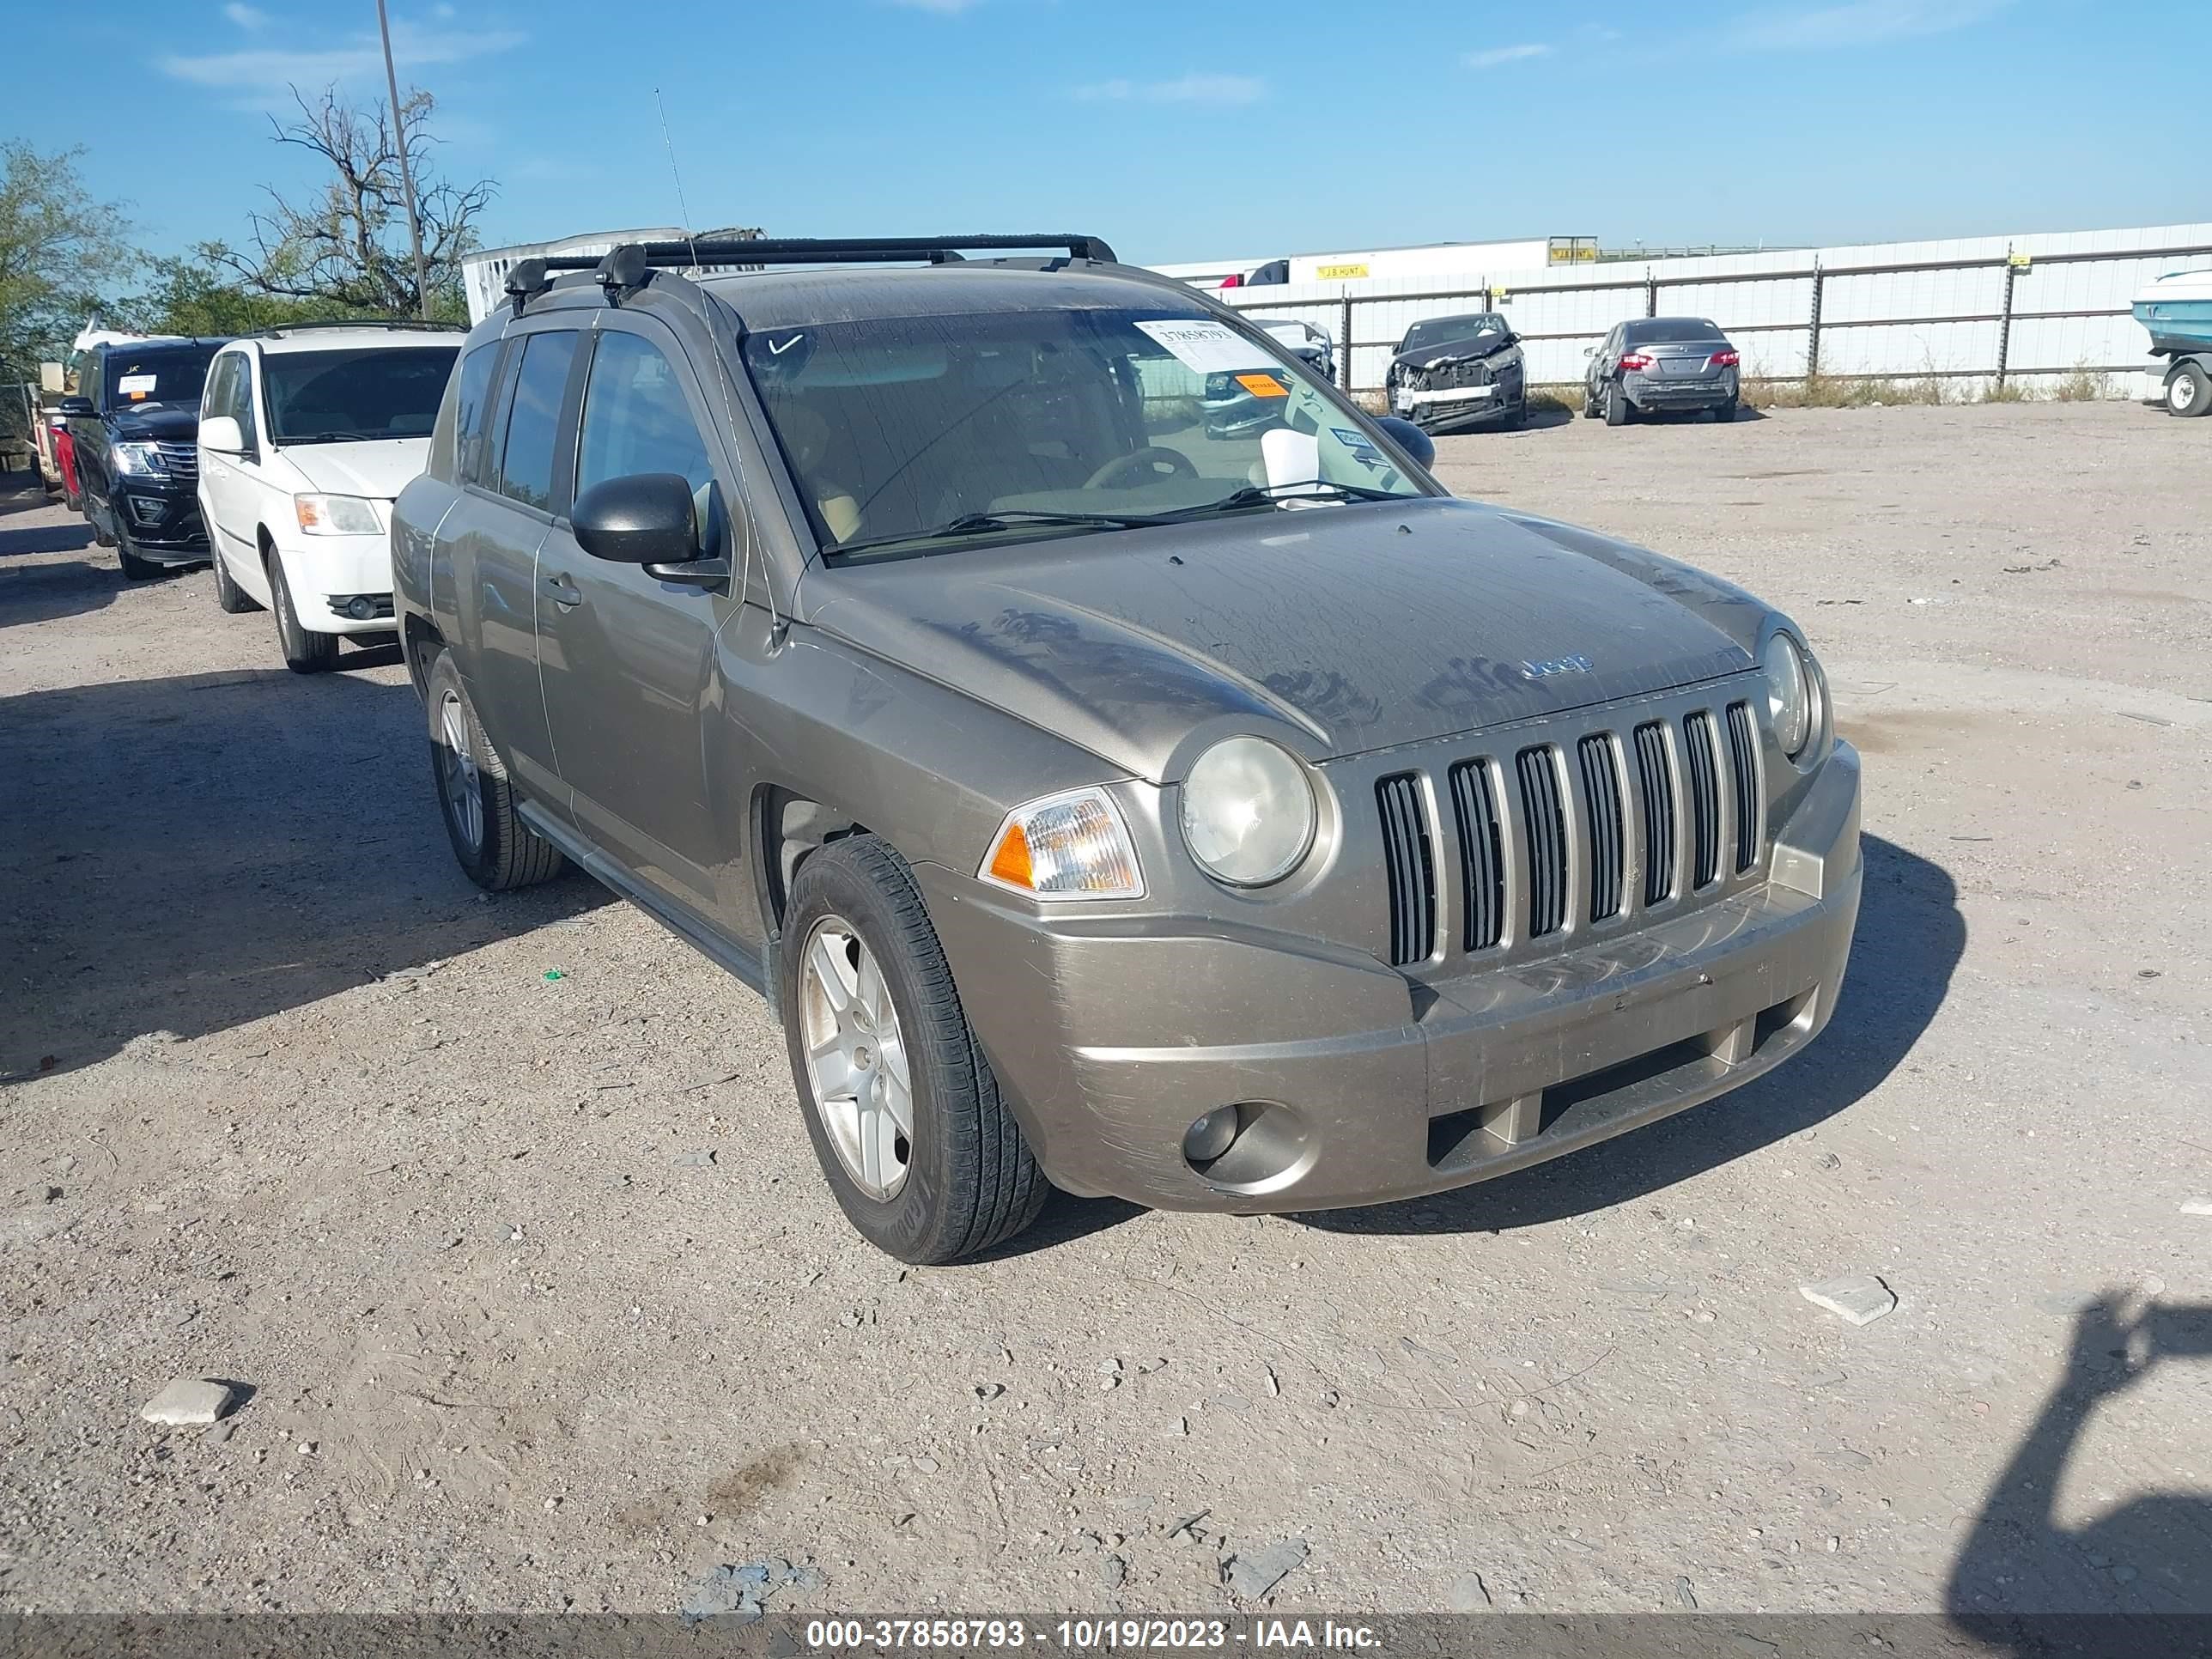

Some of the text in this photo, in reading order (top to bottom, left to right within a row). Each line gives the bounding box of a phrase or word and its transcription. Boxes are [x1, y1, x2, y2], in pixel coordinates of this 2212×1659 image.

[1340, 267, 1358, 276] HUNT
[1159, 330, 1232, 343] 37858793
[1521, 653, 1594, 680] Jeep
